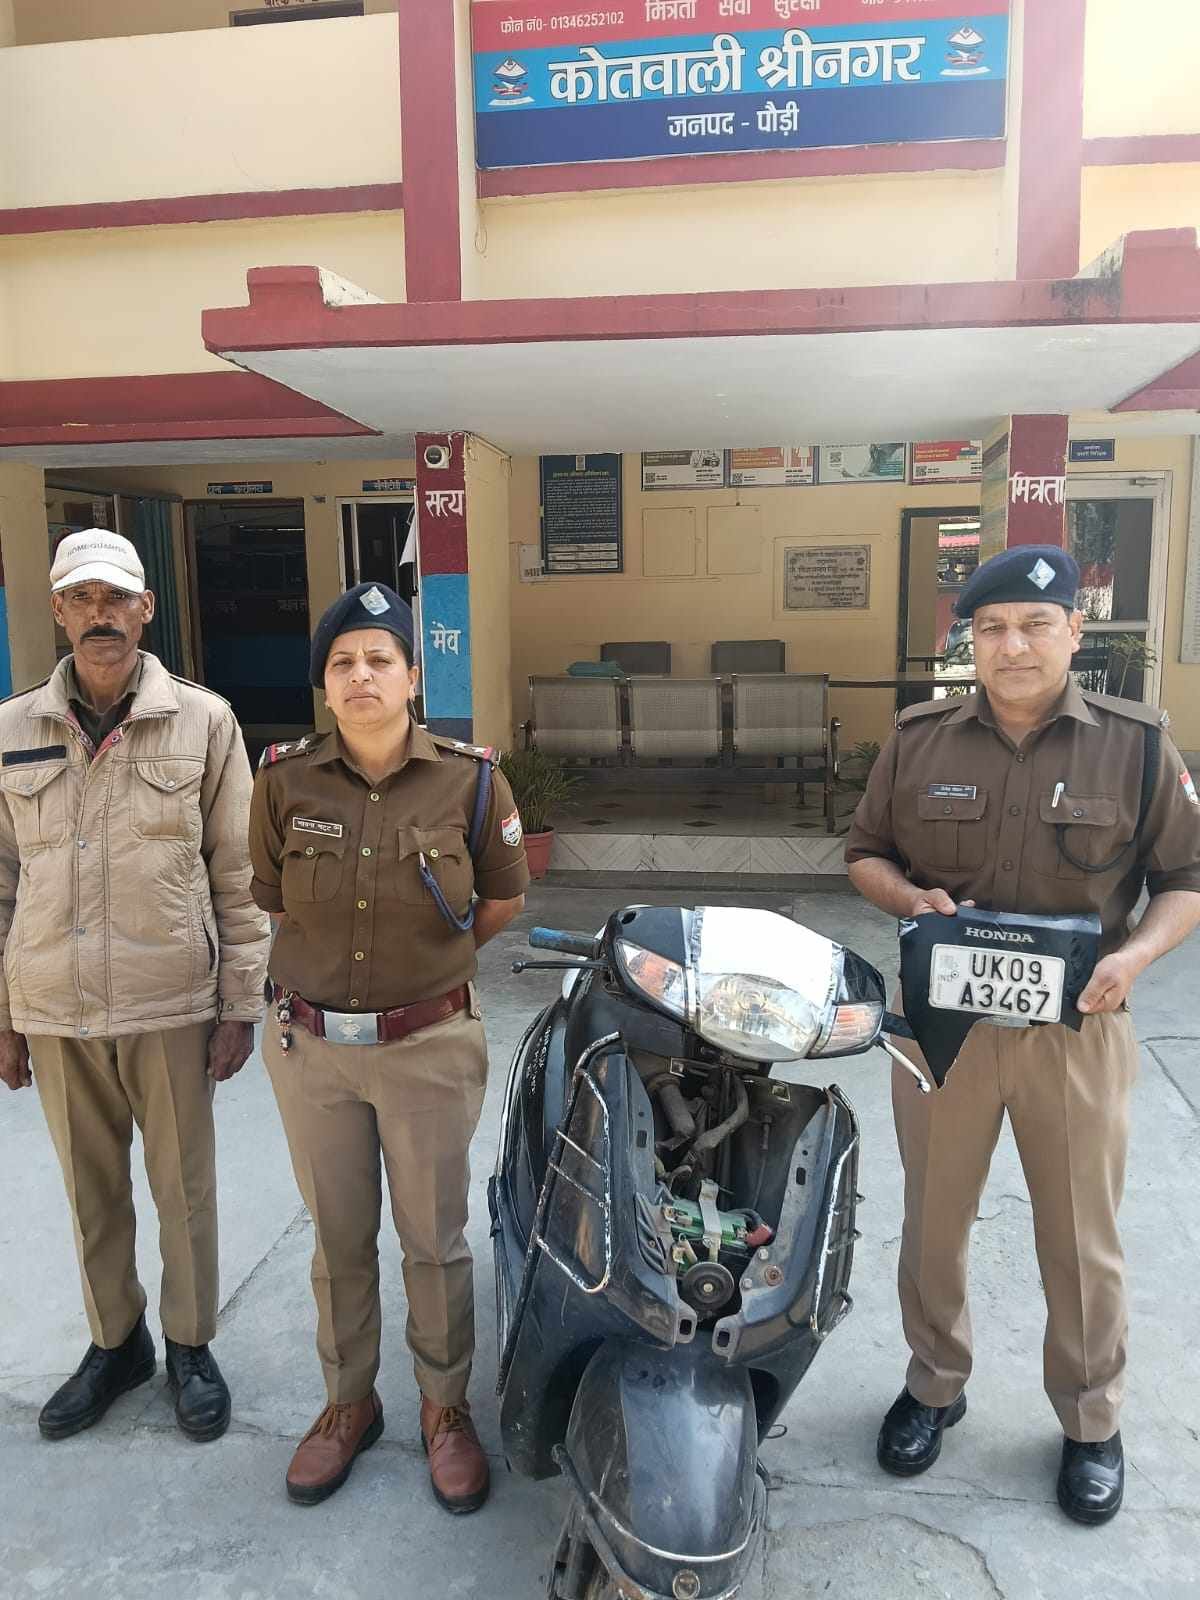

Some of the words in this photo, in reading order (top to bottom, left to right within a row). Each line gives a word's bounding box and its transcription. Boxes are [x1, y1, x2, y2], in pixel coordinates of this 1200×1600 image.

[500, 16, 524, 33] फोन
[551, 11, 625, 30] 01346252102
[719, 0, 751, 17] सवा
[548, 33, 746, 103] कोतवाली
[756, 28, 927, 89] श्रीनगर
[667, 112, 736, 137] जनपद
[756, 100, 800, 136] पौड़ी
[425, 489, 465, 517] सत्य
[1008, 471, 1067, 506] मित्रता
[964, 926, 1035, 944] HONDA
[971, 952, 1043, 986] UK09
[960, 981, 1050, 1016] A3467
